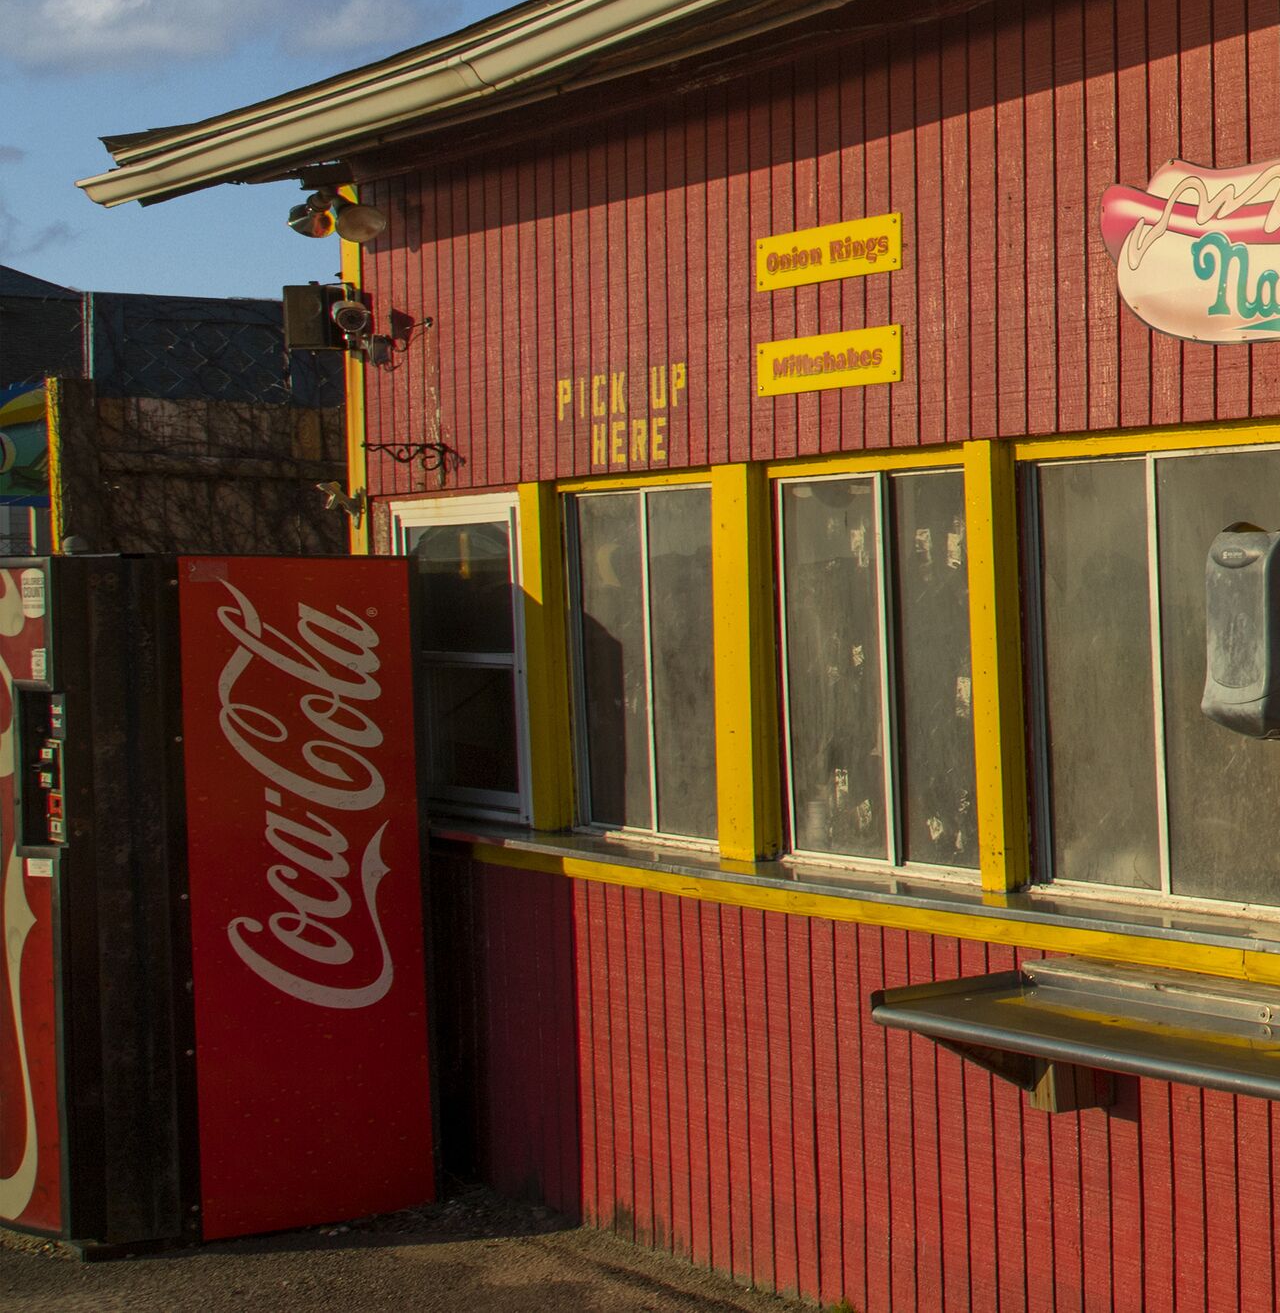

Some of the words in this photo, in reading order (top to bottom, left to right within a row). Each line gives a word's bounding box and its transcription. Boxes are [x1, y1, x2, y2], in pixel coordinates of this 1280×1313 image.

[766, 244, 823, 276] Onion
[829, 236, 889, 264] Rings
[772, 347, 884, 379] Milkshakes
[556, 371, 627, 422] PICK
[651, 362, 687, 410] UP
[592, 417, 668, 466] HERE
[216, 575, 394, 1010] Coca-Cola
